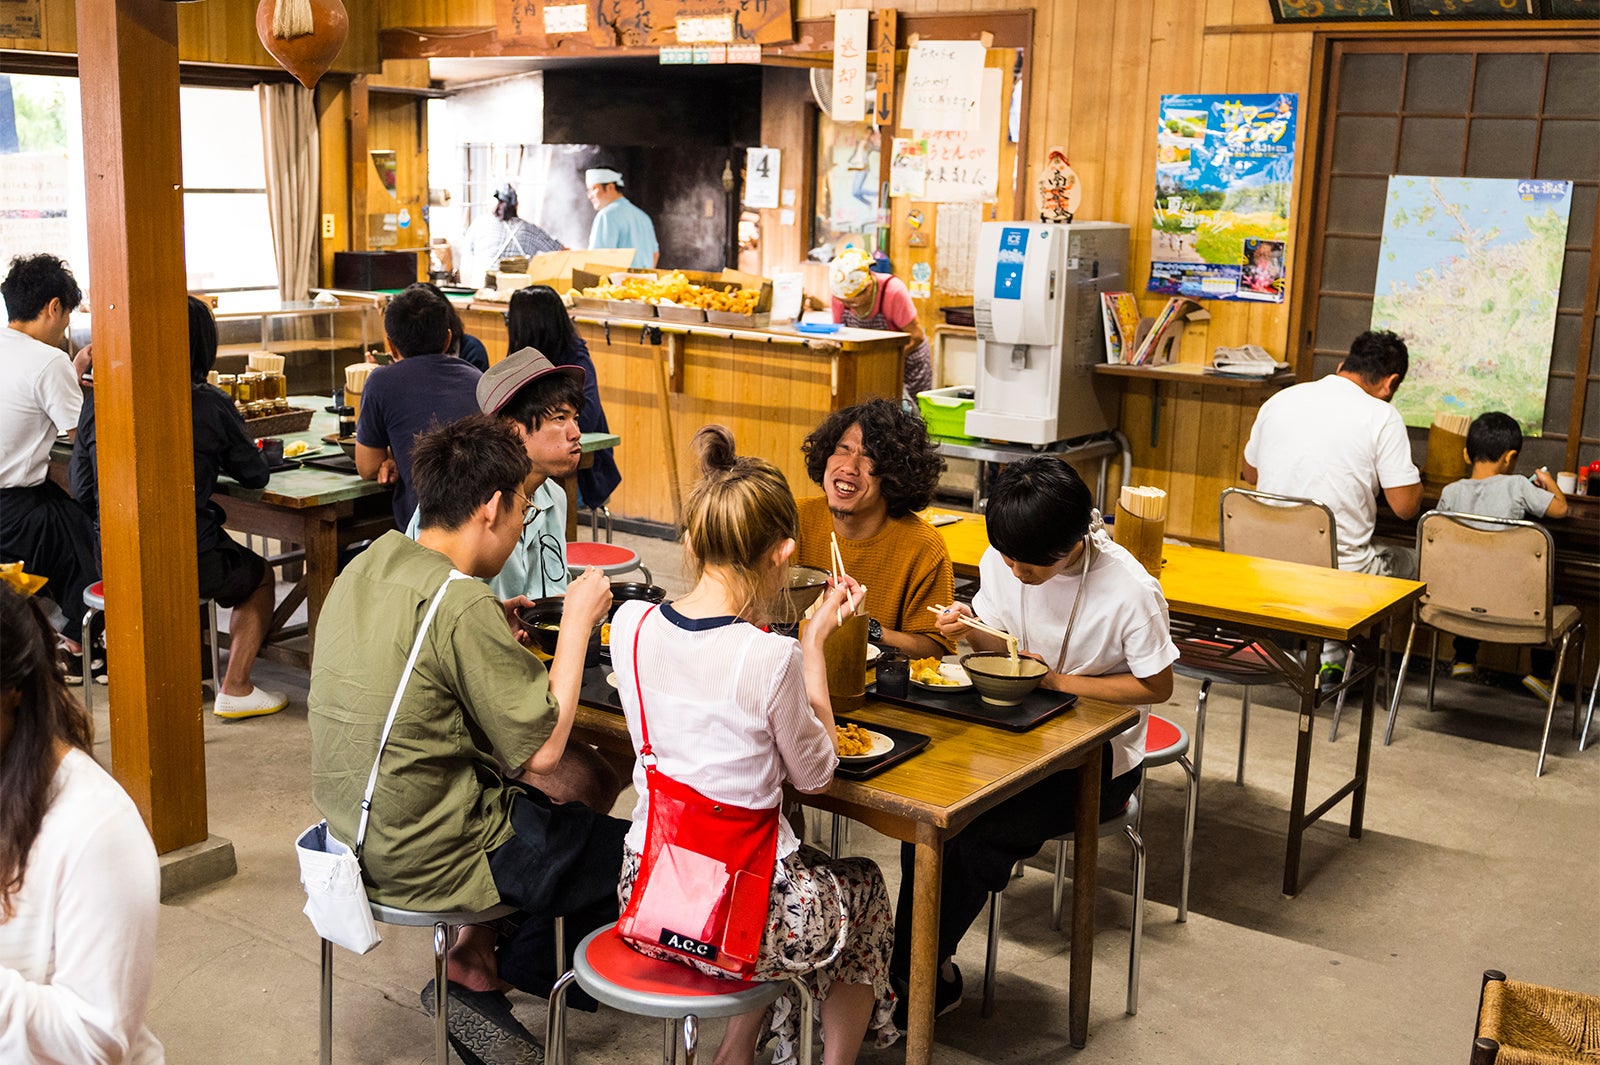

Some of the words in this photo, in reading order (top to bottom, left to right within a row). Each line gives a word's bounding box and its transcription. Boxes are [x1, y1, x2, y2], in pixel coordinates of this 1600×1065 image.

[876, 33, 894, 84] 会計
[1223, 100, 1276, 125] サマー
[1220, 121, 1287, 143] フェスタ
[756, 155, 771, 178] 4
[1007, 235, 1021, 243] ICE
[668, 934, 708, 956] A.C.C
